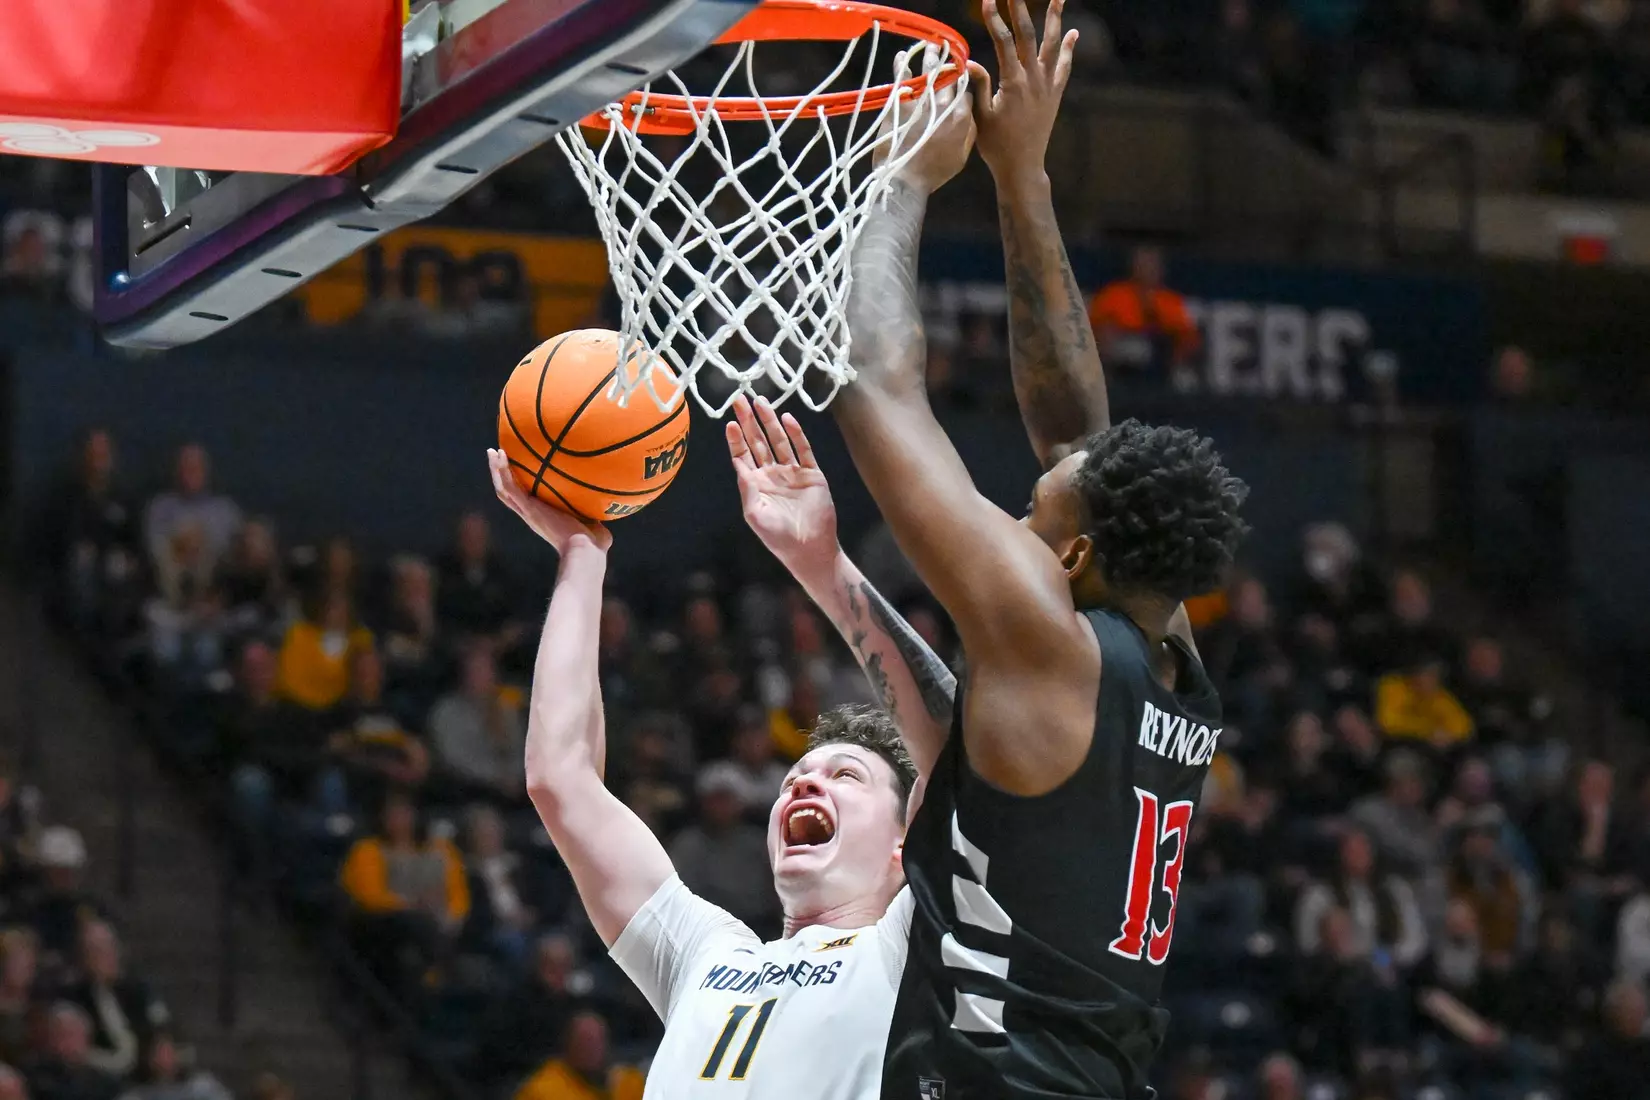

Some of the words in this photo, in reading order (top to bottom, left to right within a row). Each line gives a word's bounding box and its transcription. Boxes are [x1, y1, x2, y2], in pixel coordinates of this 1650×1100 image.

[643, 430, 689, 480] CAA
[1108, 785, 1193, 966] 13
[698, 997, 779, 1081] 11
